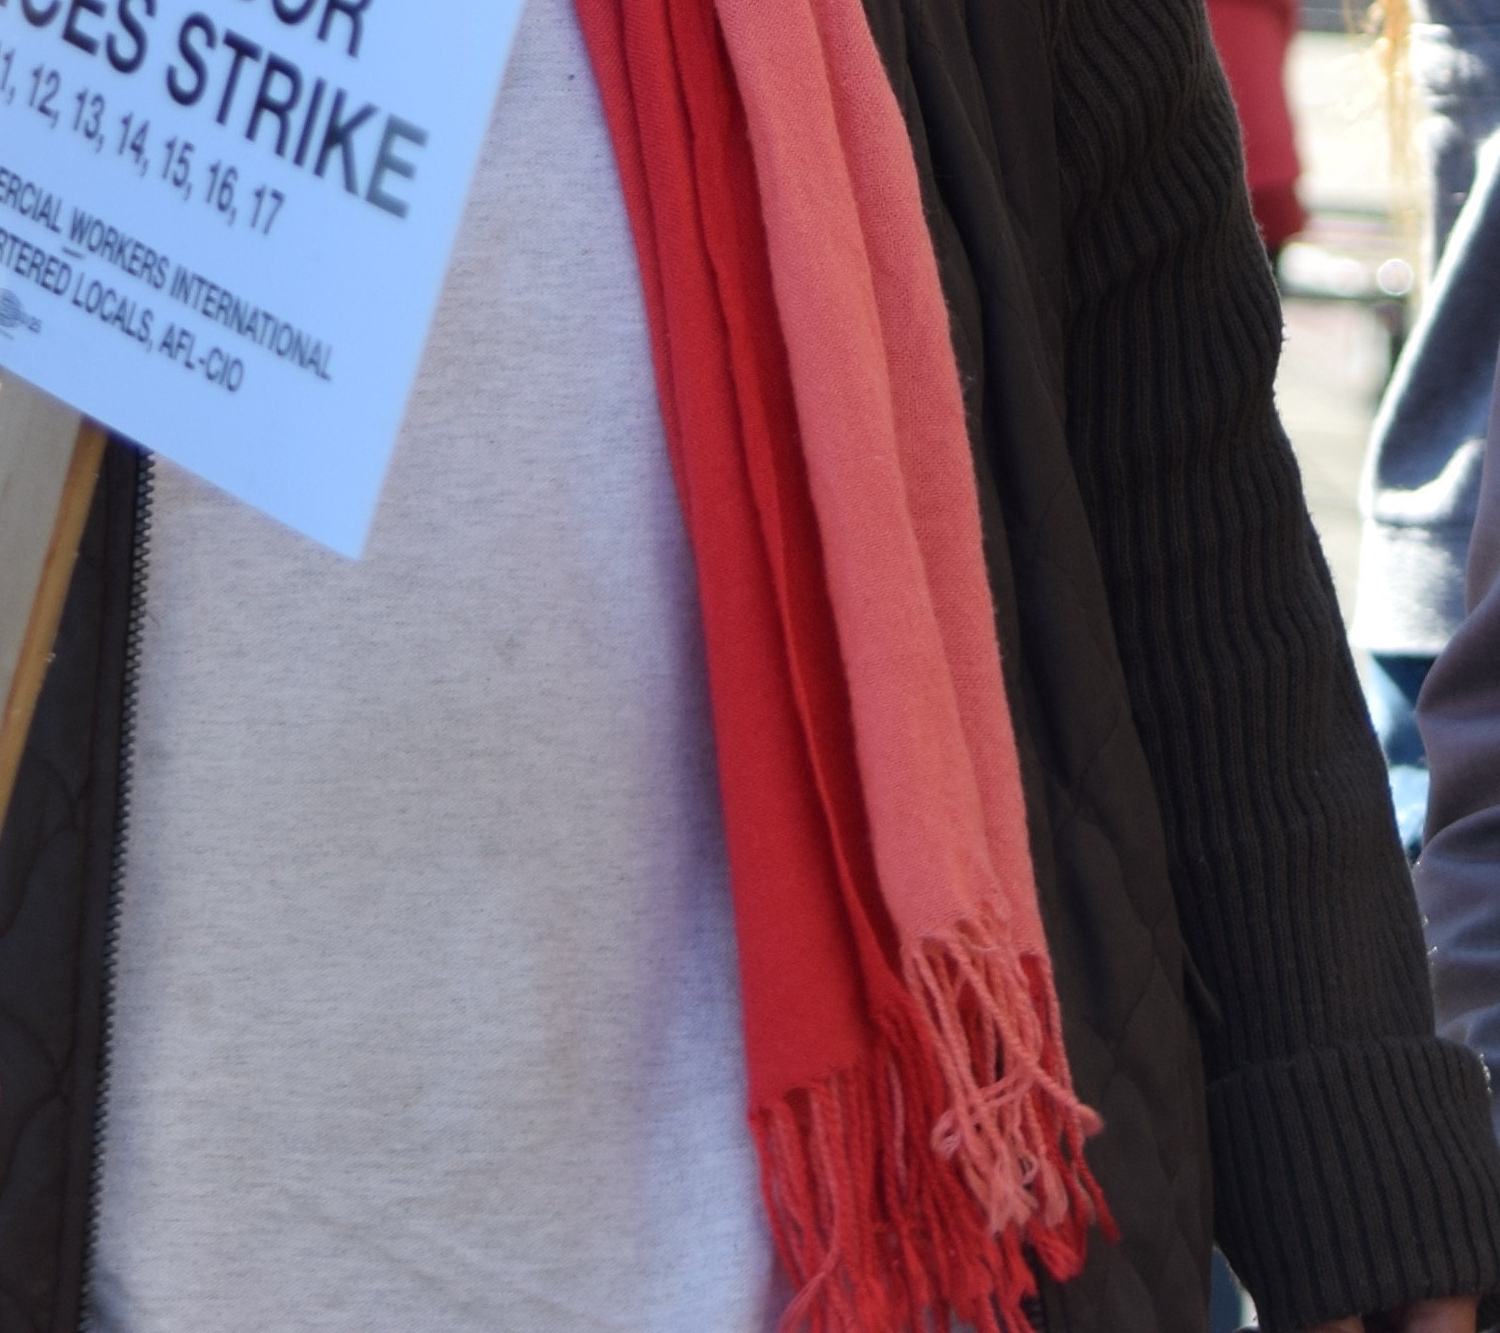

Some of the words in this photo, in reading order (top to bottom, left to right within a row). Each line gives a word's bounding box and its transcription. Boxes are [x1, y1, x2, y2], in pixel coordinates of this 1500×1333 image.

[28, 65, 61, 128] 12,
[72, 89, 105, 153] 13,
[117, 113, 150, 176] 14,
[162, 137, 195, 200] 15,
[205, 161, 238, 225] 16,
[250, 185, 286, 235] 17
[165, 11, 429, 220] STRIKE
[65, 209, 169, 290] WORKERS
[169, 265, 330, 381] INTERNATIONAL
[71, 274, 153, 349] LOCALS,
[158, 324, 244, 393] AFL-CIO
